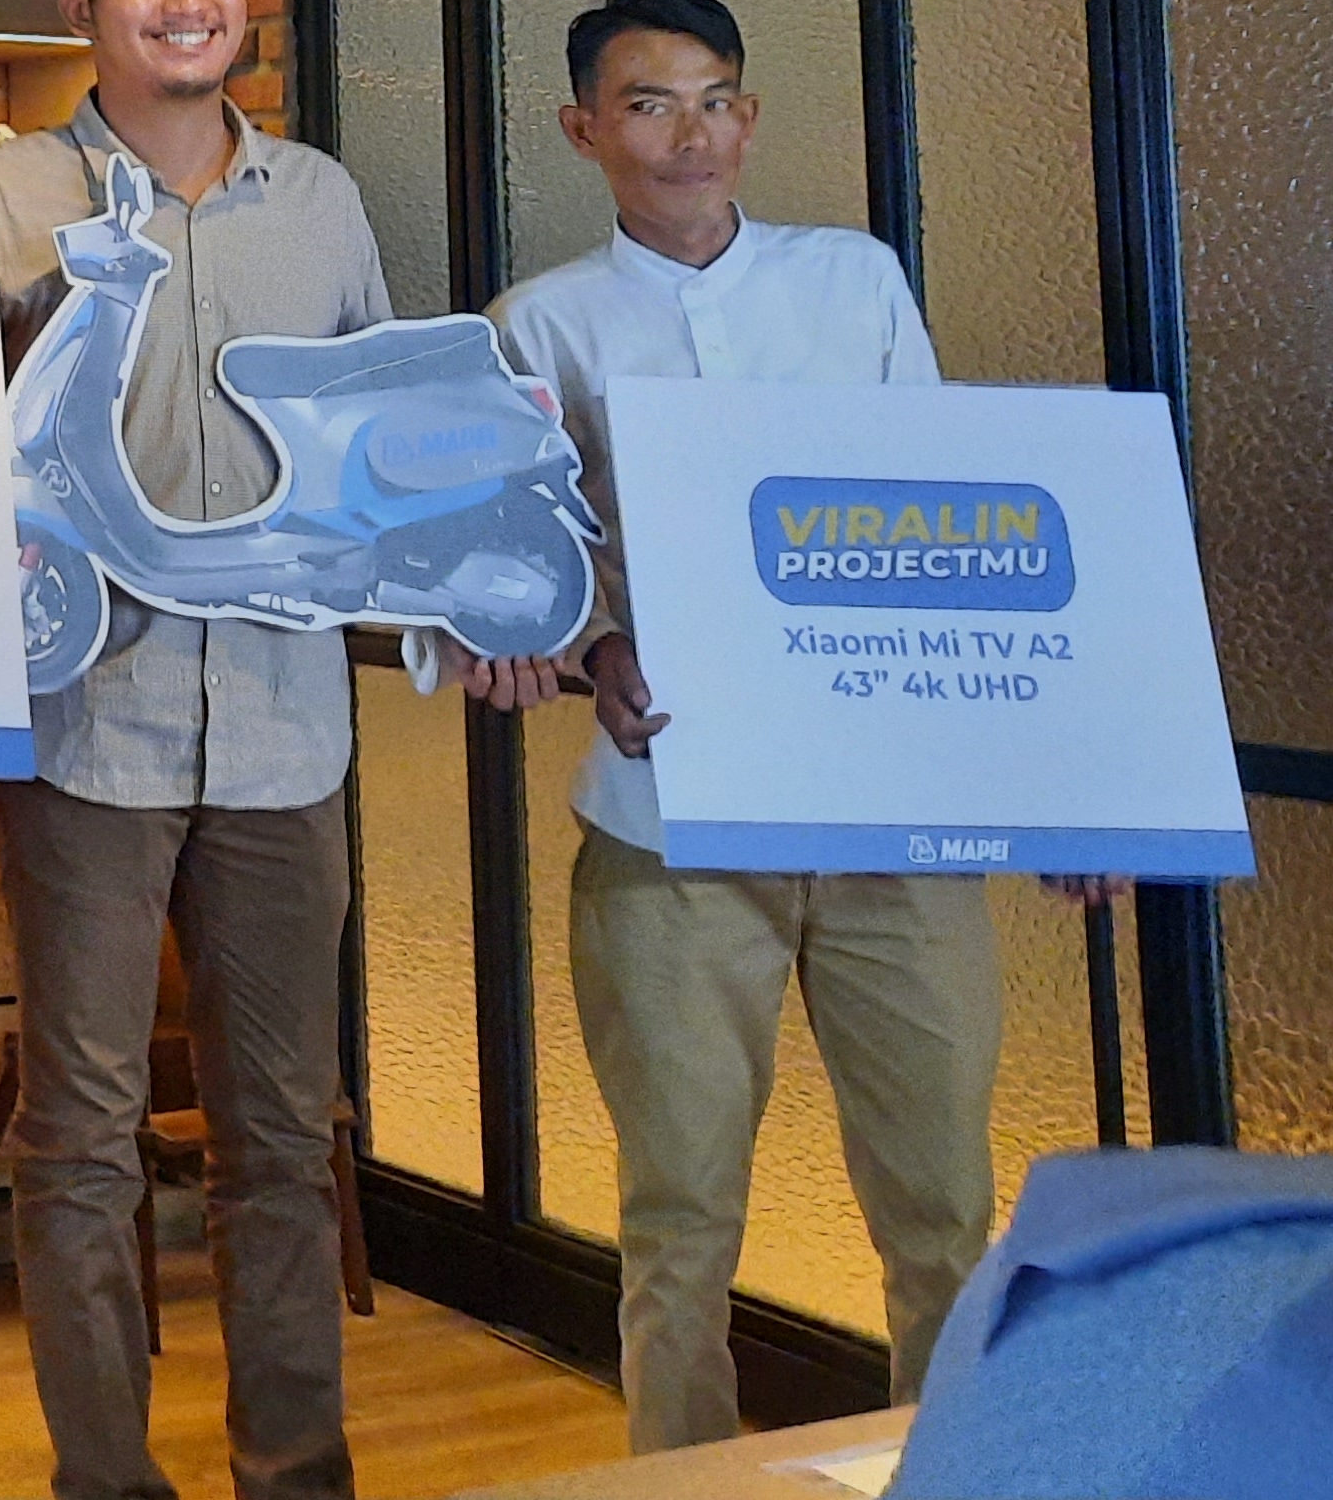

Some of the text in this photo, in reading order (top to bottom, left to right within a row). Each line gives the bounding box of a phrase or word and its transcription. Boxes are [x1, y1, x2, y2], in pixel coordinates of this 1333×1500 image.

[777, 501, 1040, 548] VIRALIN
[776, 546, 1049, 582] PROJECTMU
[784, 626, 1072, 661] Xiaomi Mi TV A2
[902, 670, 949, 700] 4k
[957, 672, 1040, 702] UHD
[940, 838, 1010, 862] MAPEI
